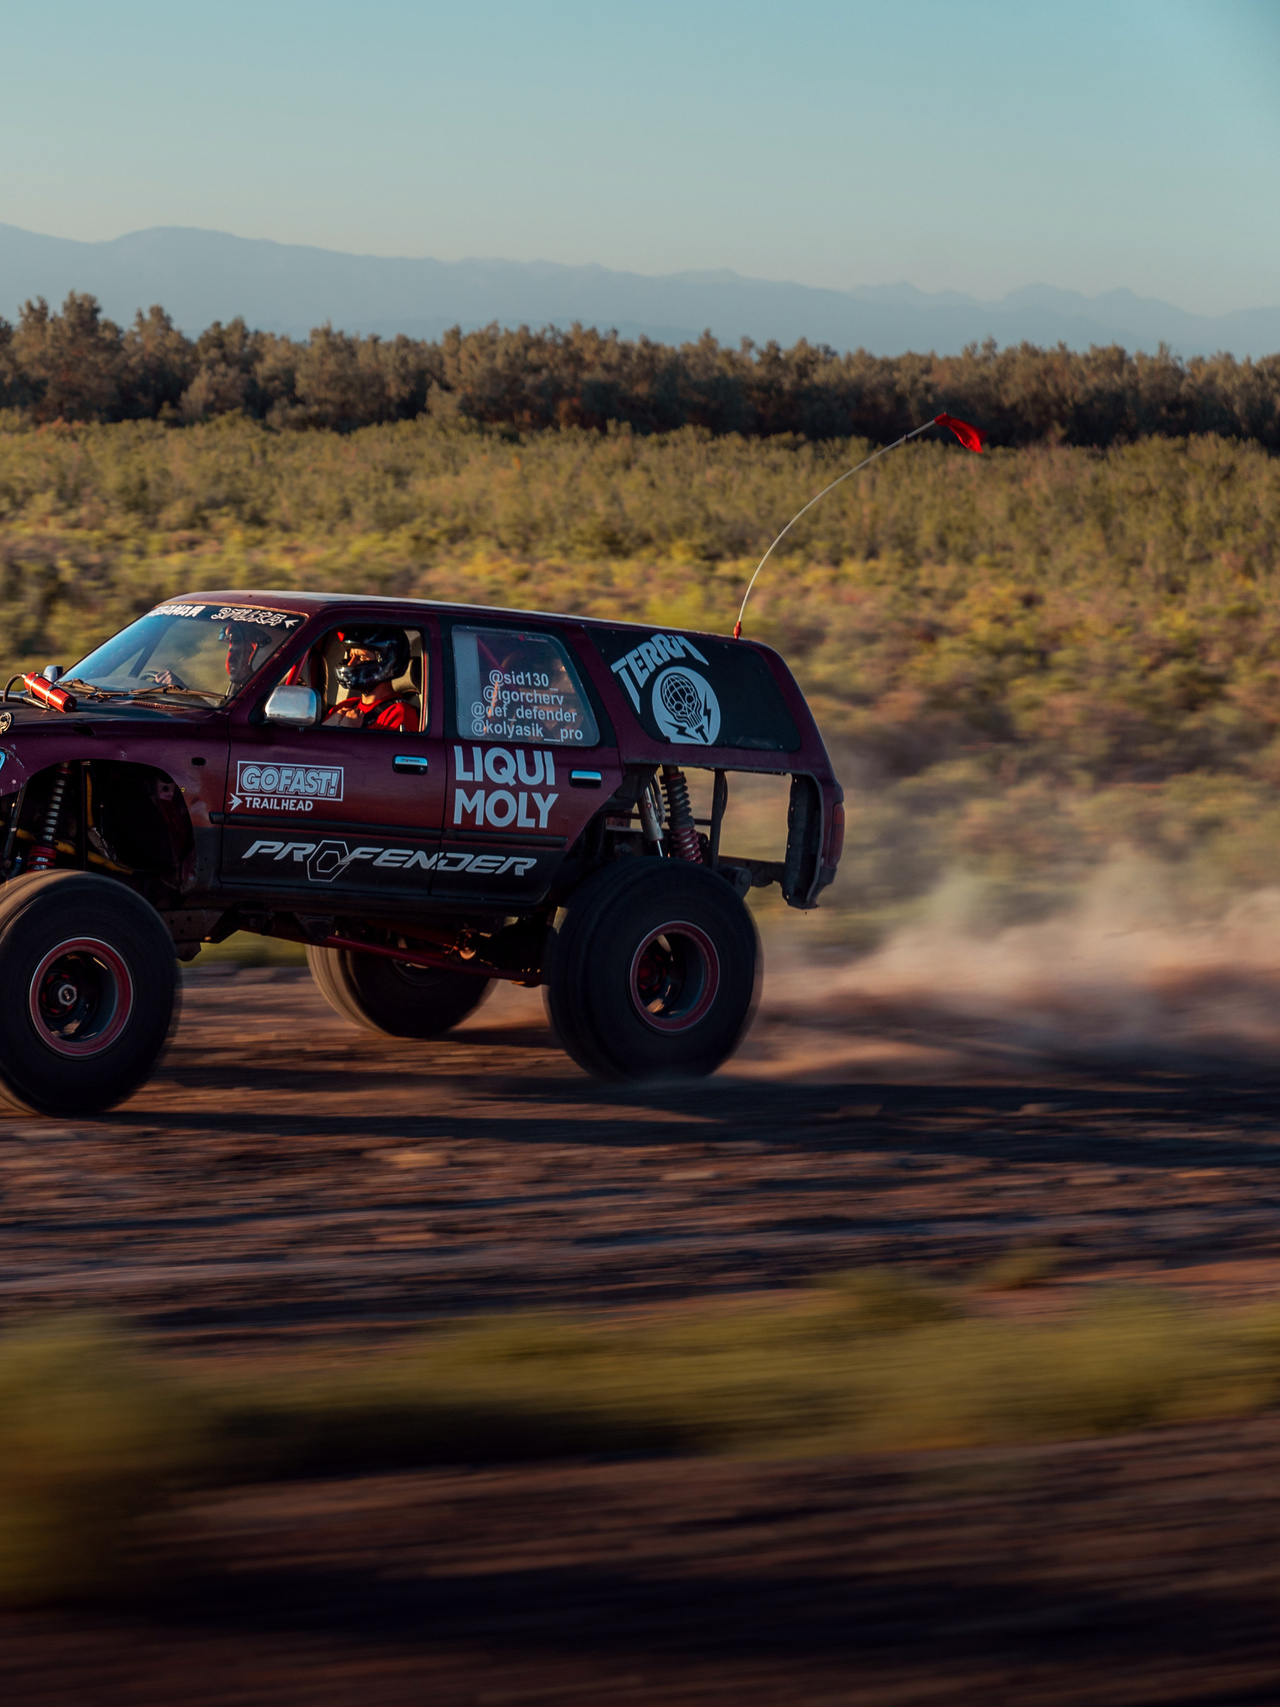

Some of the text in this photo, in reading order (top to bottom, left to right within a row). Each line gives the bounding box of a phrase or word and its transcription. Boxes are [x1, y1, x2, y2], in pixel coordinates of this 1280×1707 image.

[470, 701, 578, 722] @def_defender
[483, 685, 564, 706] @igorcherv
[240, 764, 340, 798] GOFAST!
[454, 745, 556, 787] LIQUI
[245, 797, 314, 812] TRAILHEAD
[454, 788, 559, 829] MOLY
[241, 839, 538, 883] PROFENDER
